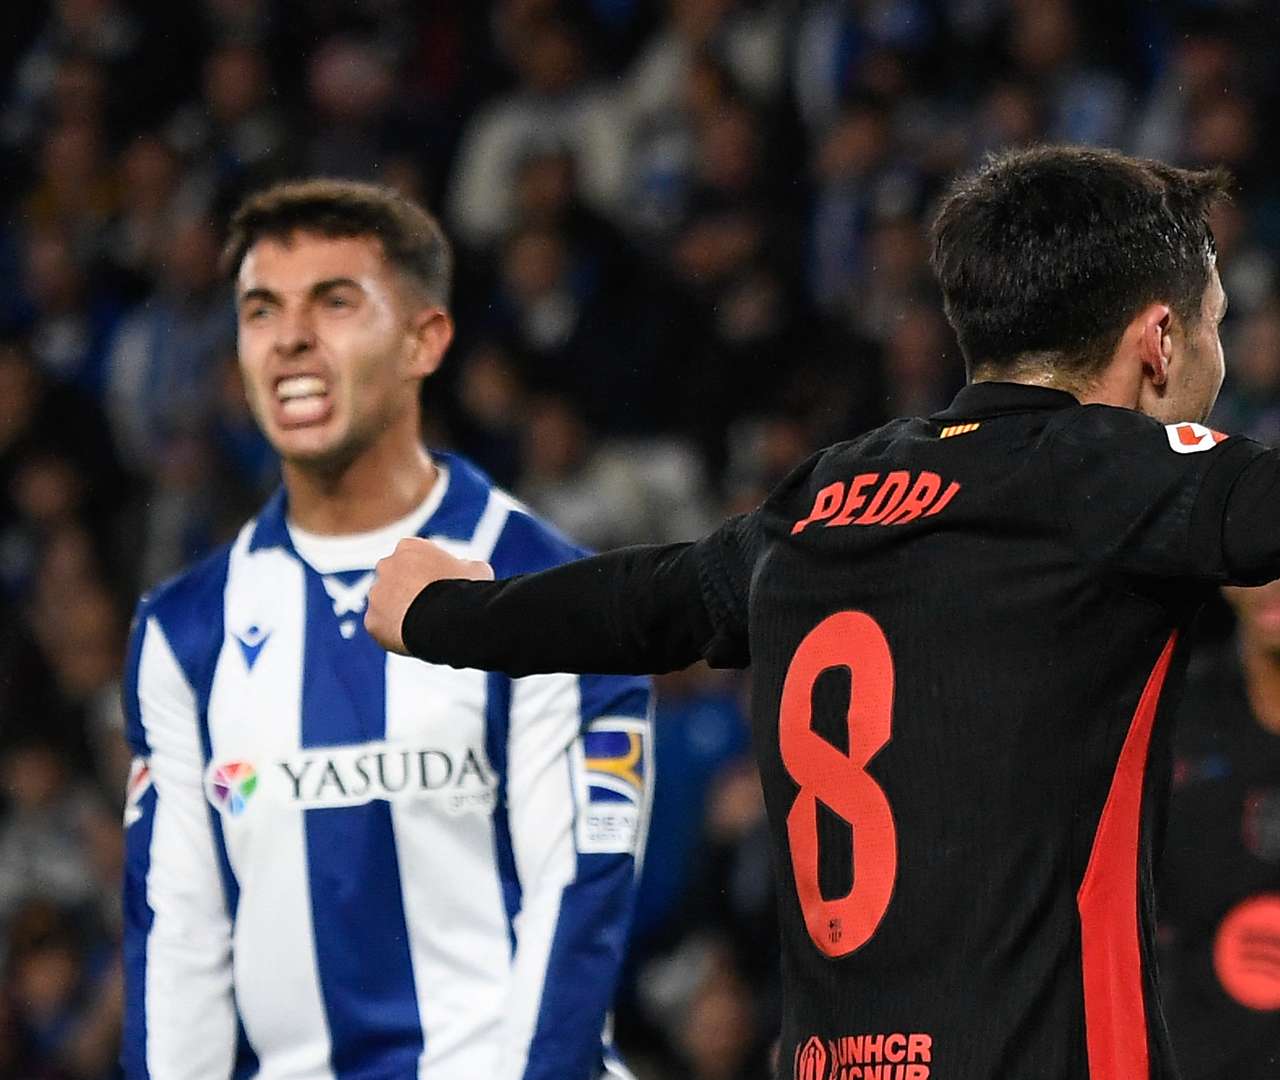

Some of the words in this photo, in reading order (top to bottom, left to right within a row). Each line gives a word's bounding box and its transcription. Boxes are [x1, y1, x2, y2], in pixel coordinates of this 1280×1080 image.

[790, 470, 961, 535] PEDRI
[277, 746, 490, 799] YASUDA
[778, 610, 897, 958] 8
[837, 1033, 932, 1065] UNHCR
